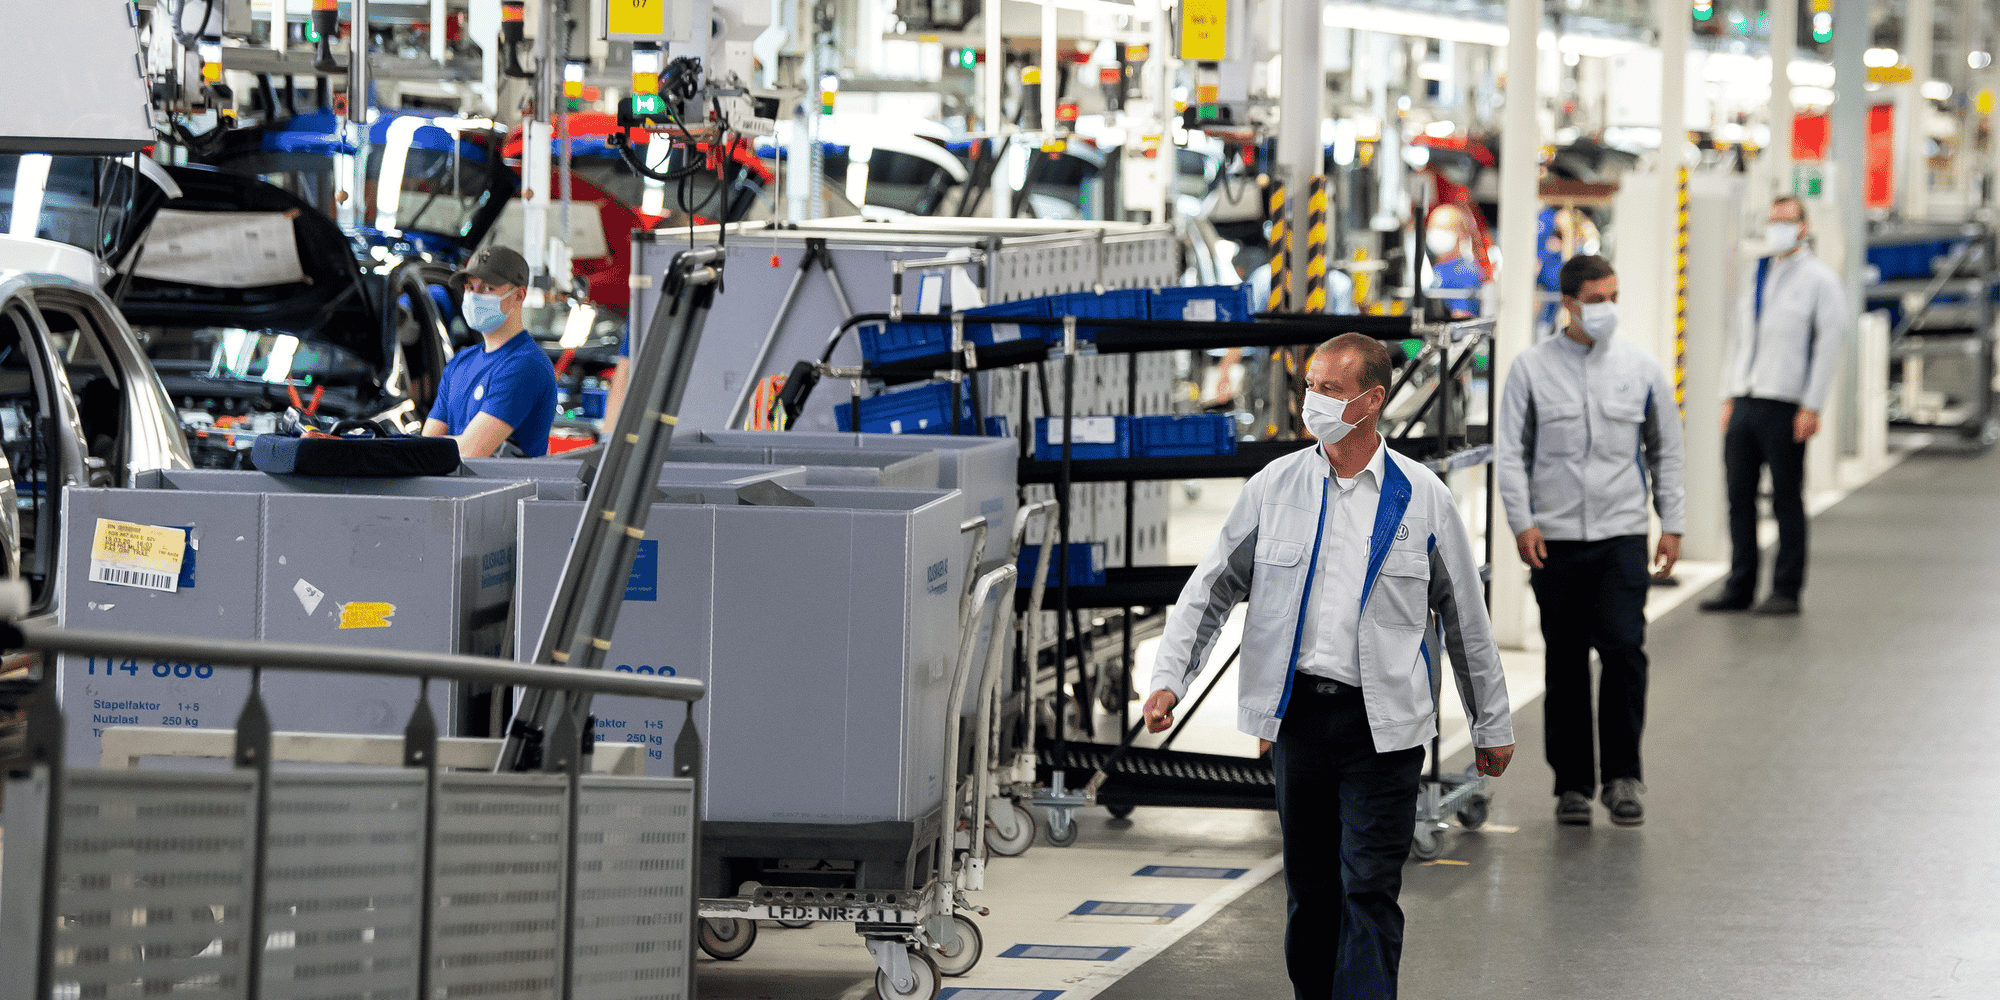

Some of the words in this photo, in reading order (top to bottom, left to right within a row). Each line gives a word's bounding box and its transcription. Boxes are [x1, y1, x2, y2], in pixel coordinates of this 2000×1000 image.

[633, 0, 647, 8] 07
[88, 656, 138, 676] 114
[93, 699, 160, 711] Stapelfaktor
[93, 714, 139, 725] Nutzlast
[162, 716, 182, 726] 250
[185, 716, 199, 728] kg
[593, 718, 627, 729] faktor
[644, 720, 664, 730] 1+5
[626, 733, 647, 743] 250
[649, 734, 663, 746] kg
[648, 747, 662, 760] kg
